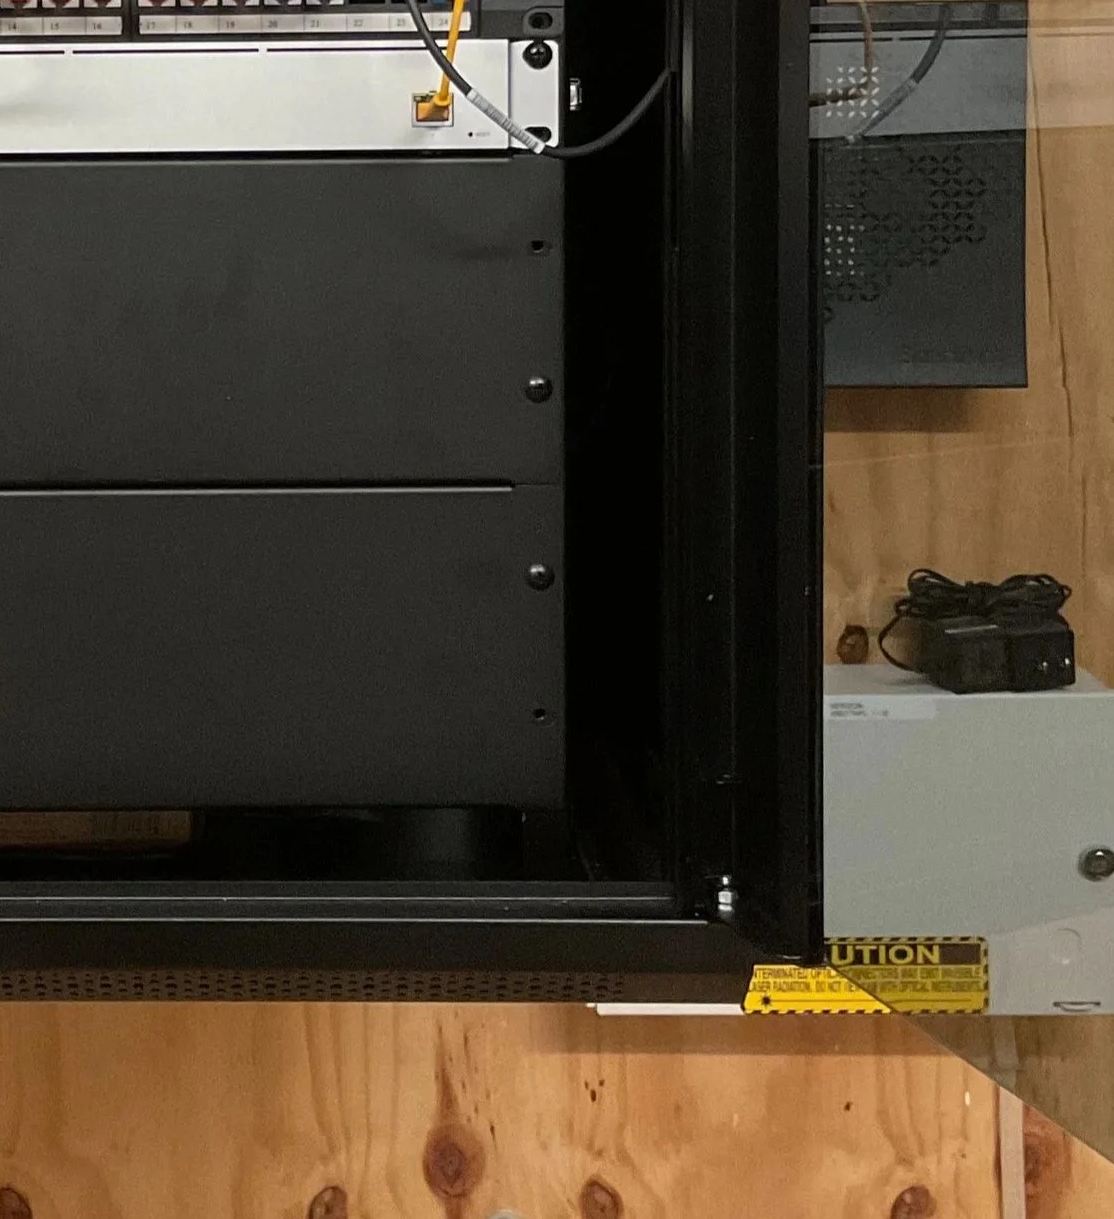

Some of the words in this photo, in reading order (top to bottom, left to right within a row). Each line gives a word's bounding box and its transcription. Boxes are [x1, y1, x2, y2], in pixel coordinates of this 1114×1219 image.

[8, 22, 17, 31] 14
[50, 22, 60, 30] 15
[93, 22, 102, 30] 16
[146, 21, 156, 30] 17
[183, 21, 193, 29] 18
[226, 20, 235, 29] 19
[268, 20, 278, 29] 20
[310, 19, 320, 28] 21
[353, 18, 363, 27] 22
[396, 18, 406, 27] 23
[439, 18, 449, 26] 24
[830, 944, 940, 966] UTION
